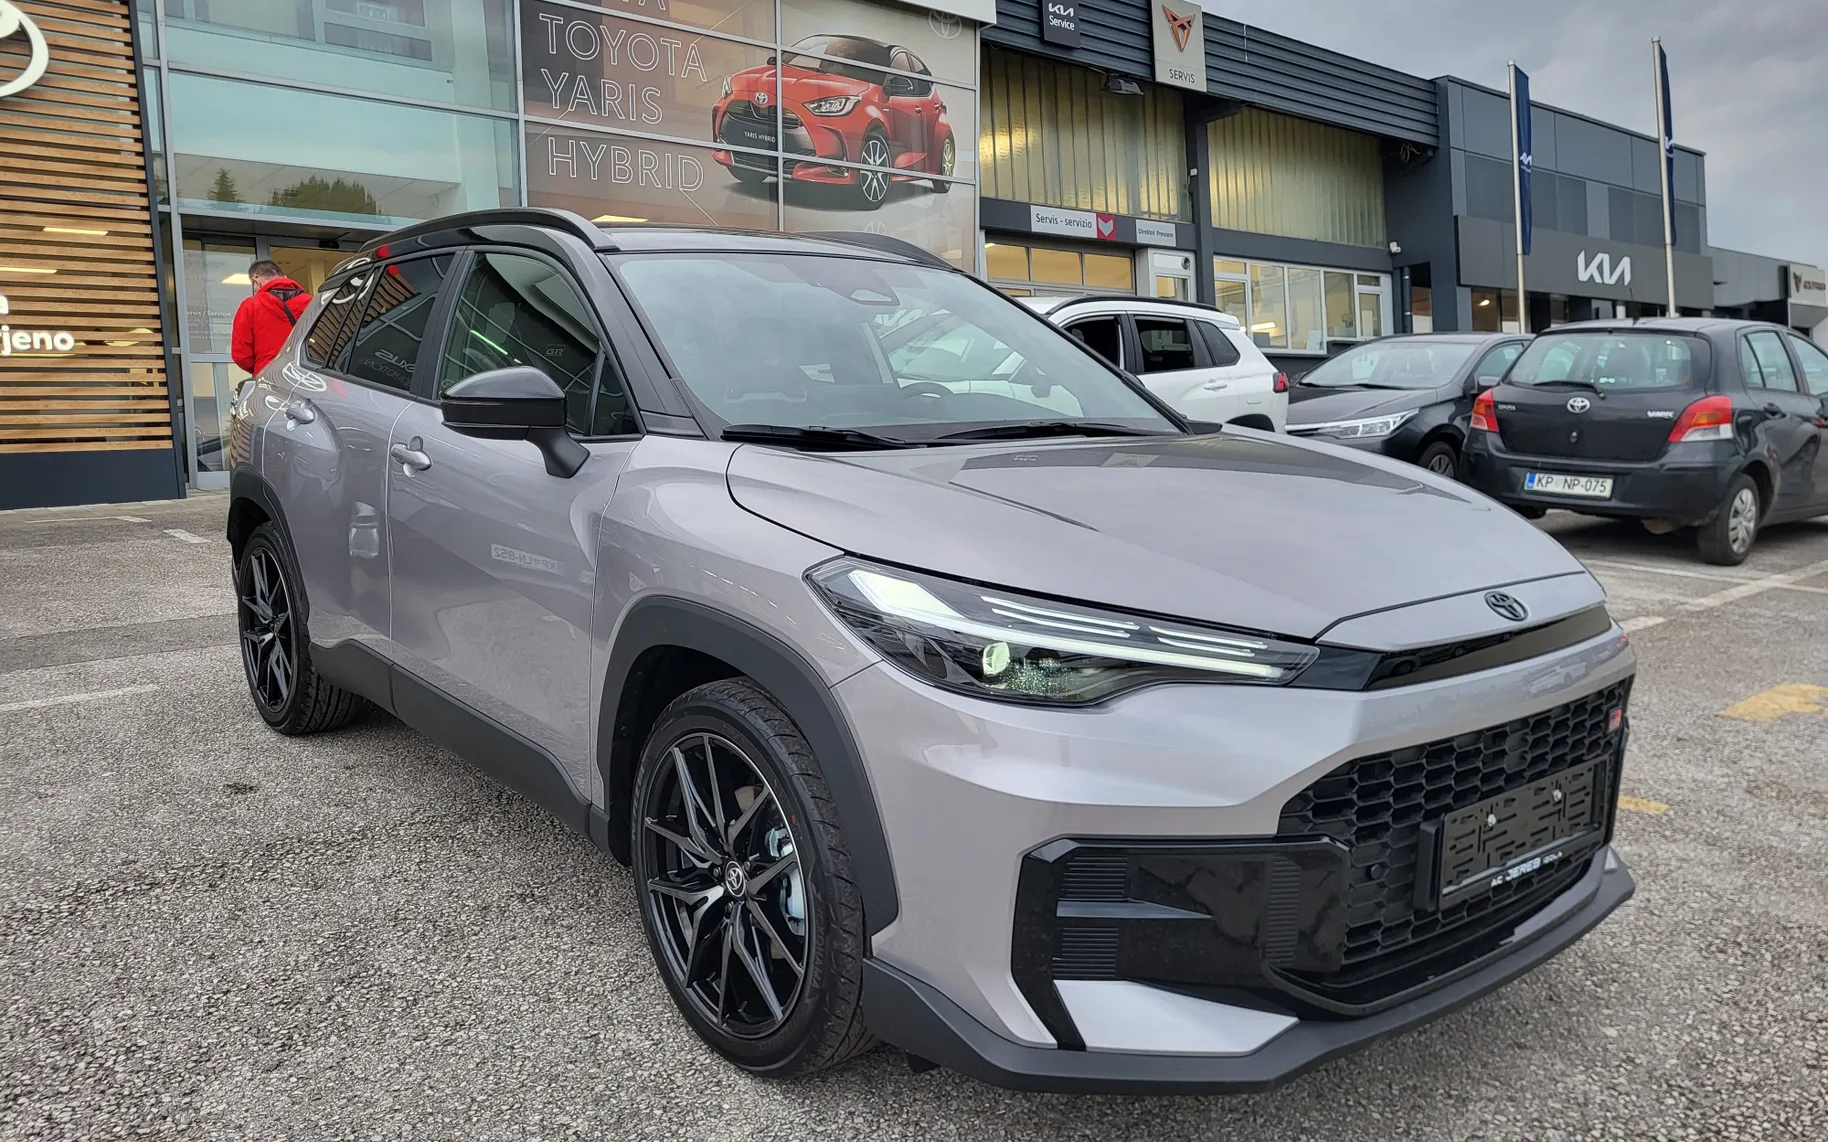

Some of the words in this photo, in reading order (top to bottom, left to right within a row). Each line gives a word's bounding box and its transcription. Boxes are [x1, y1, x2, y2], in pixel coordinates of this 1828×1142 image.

[1048, 2, 1074, 17] KIA
[1049, 15, 1075, 31] Service
[539, 13, 708, 82] TOYOTA
[1169, 68, 1196, 84] SERVIS
[540, 68, 663, 125] YARIS
[744, 130, 758, 140] YARIS
[758, 133, 776, 143] HYBRID
[548, 136, 704, 192] HYBRID
[1035, 213, 1059, 225] Servis
[1064, 218, 1093, 229] servizio
[1577, 249, 1631, 287] KIA
[0, 325, 75, 356] jeno
[1536, 475, 1554, 488] KP
[1562, 477, 1607, 493] NP-075
